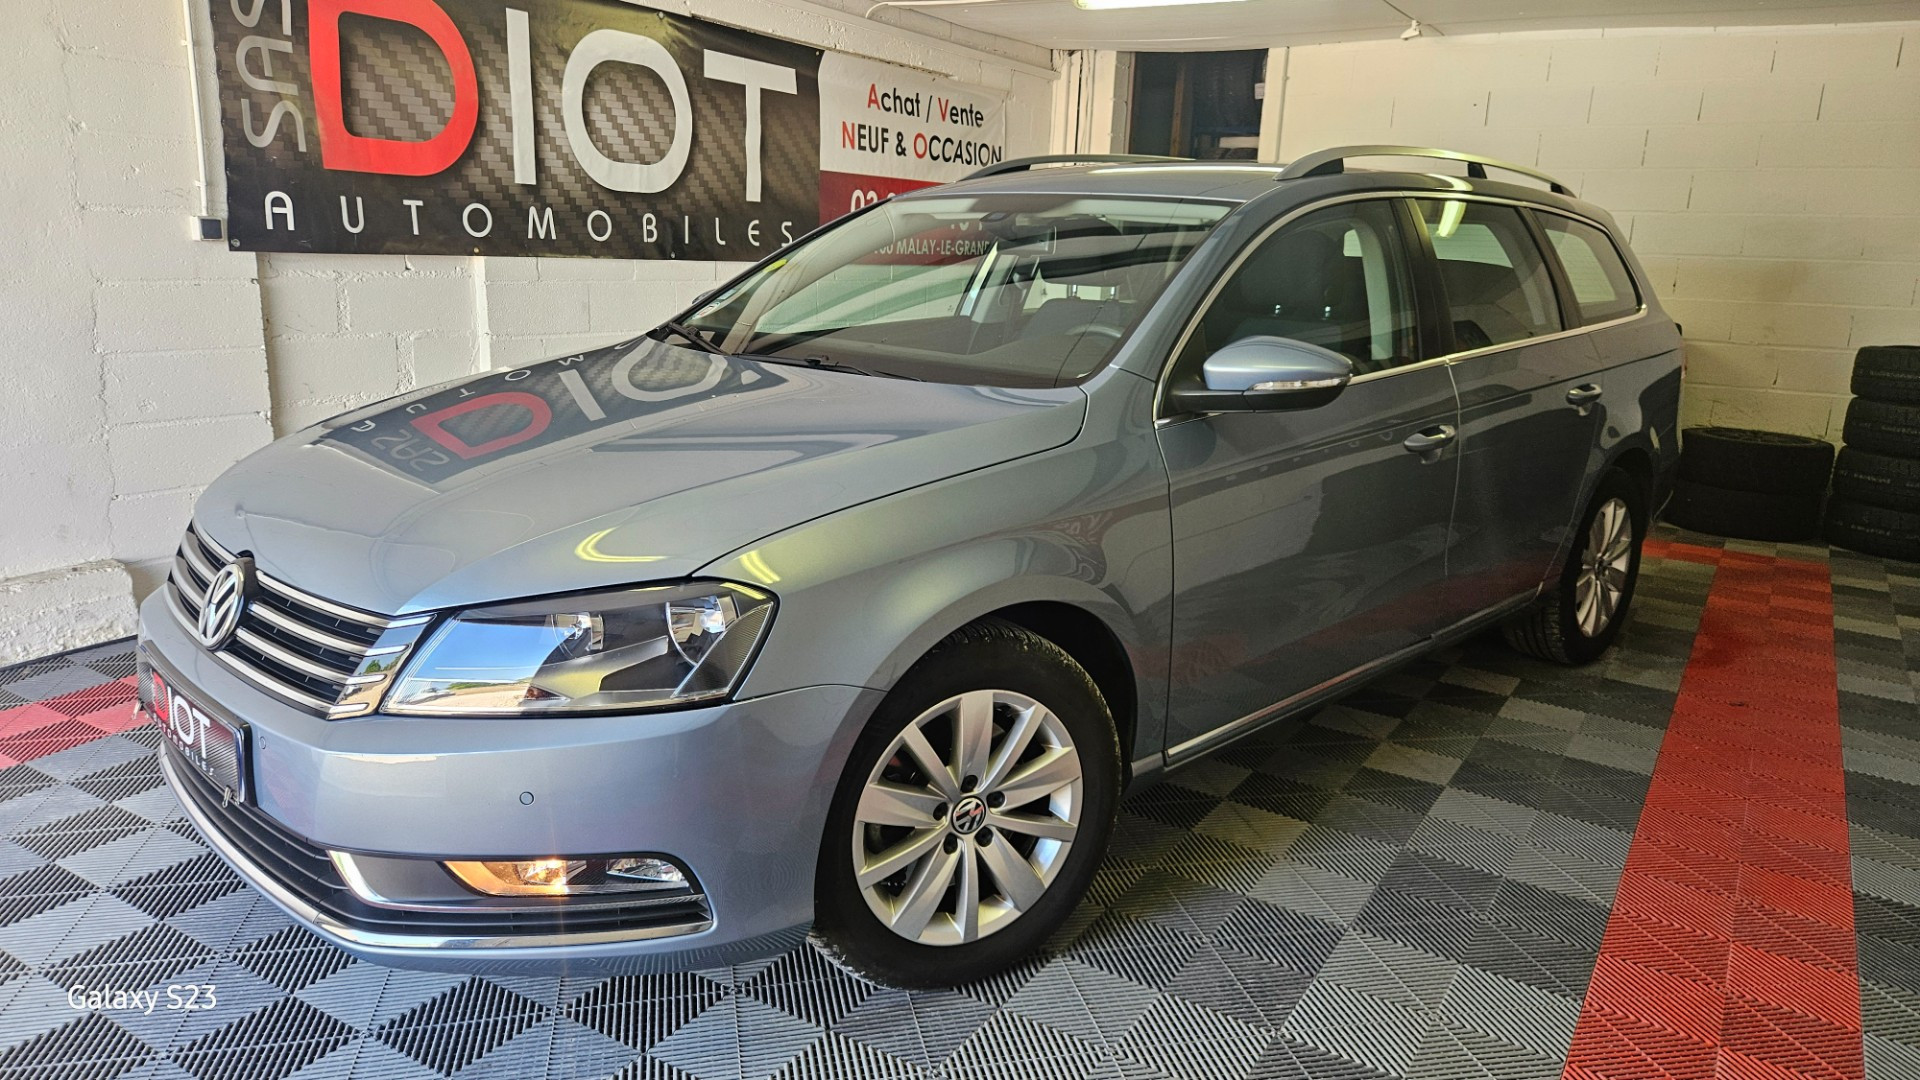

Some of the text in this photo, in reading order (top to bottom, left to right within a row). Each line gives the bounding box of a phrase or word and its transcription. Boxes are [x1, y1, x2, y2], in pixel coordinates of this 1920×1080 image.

[229, 0, 307, 153] SAS
[308, 0, 797, 203] DIOT
[867, 83, 984, 128] Achat / Vente
[842, 121, 1002, 167] NEUF & OCCASION
[265, 190, 793, 247] AUTOMOBILES
[153, 671, 211, 760] DIOT
